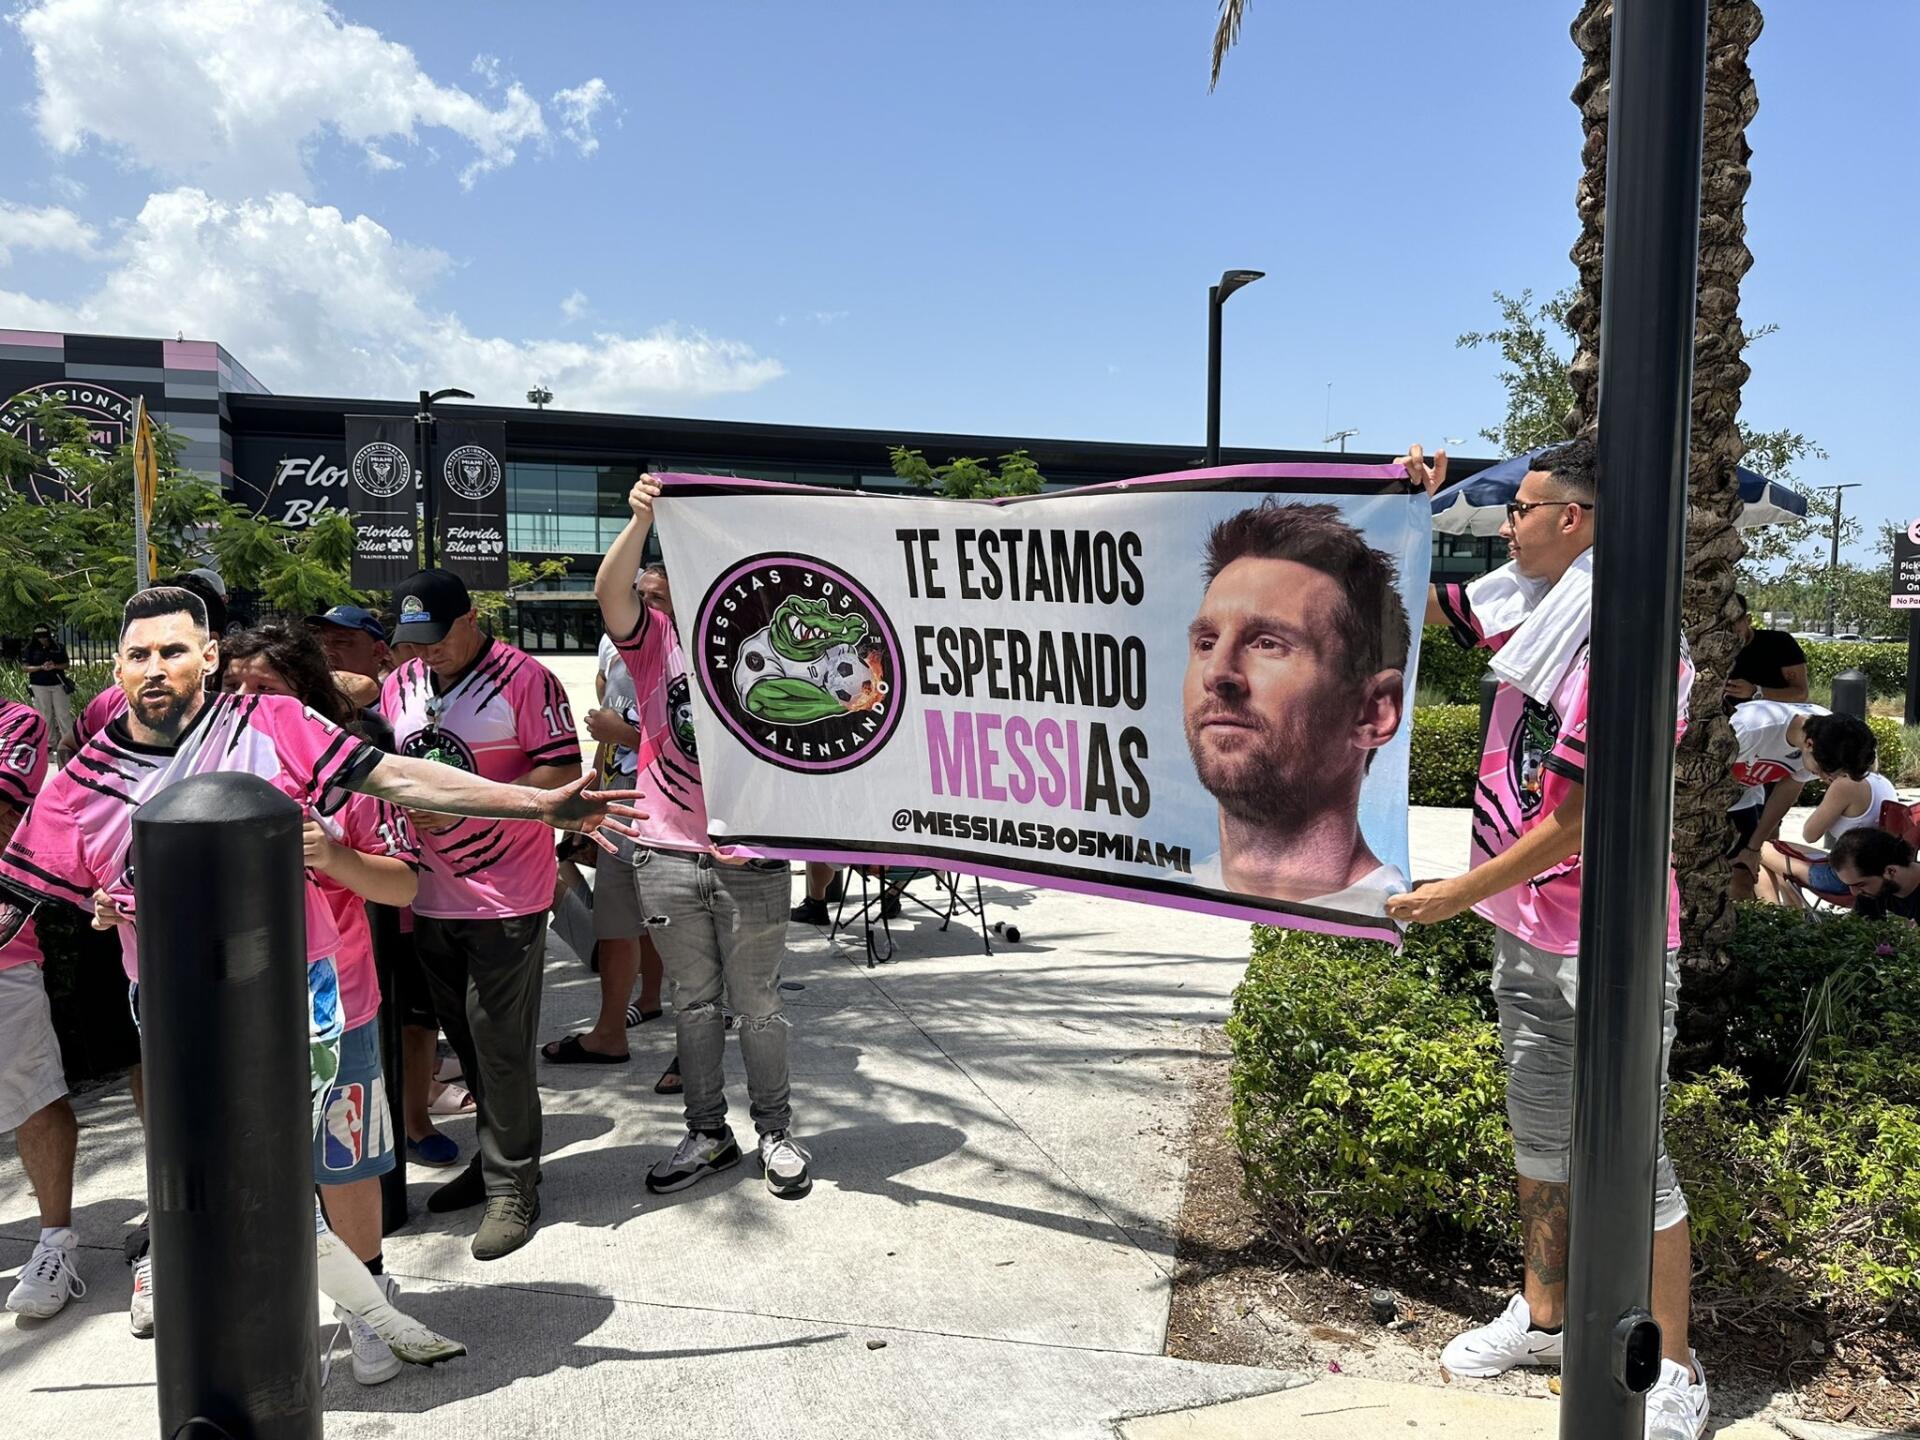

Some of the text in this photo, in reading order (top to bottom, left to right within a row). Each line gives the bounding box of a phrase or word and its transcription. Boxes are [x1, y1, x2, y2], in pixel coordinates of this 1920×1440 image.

[0, 389, 132, 433] ERNACIONAL
[356, 525, 411, 538] Florida
[356, 538, 386, 552] Blue
[445, 540, 476, 553] Blue
[447, 526, 501, 540] Florida
[896, 528, 1145, 606] TE ESTAMOS
[1907, 583, 1919, 591] On
[713, 570, 852, 669] MESSIAS 305
[869, 635, 882, 644] TM
[807, 665, 818, 679] 10
[914, 625, 1147, 711] ESPERANDO
[543, 703, 577, 737] 10
[765, 681, 890, 757] ALENTANDO
[924, 709, 1151, 819] MESSIAS
[377, 815, 413, 857] 10
[891, 808, 1193, 874] @MESSIAS305MIAMI
